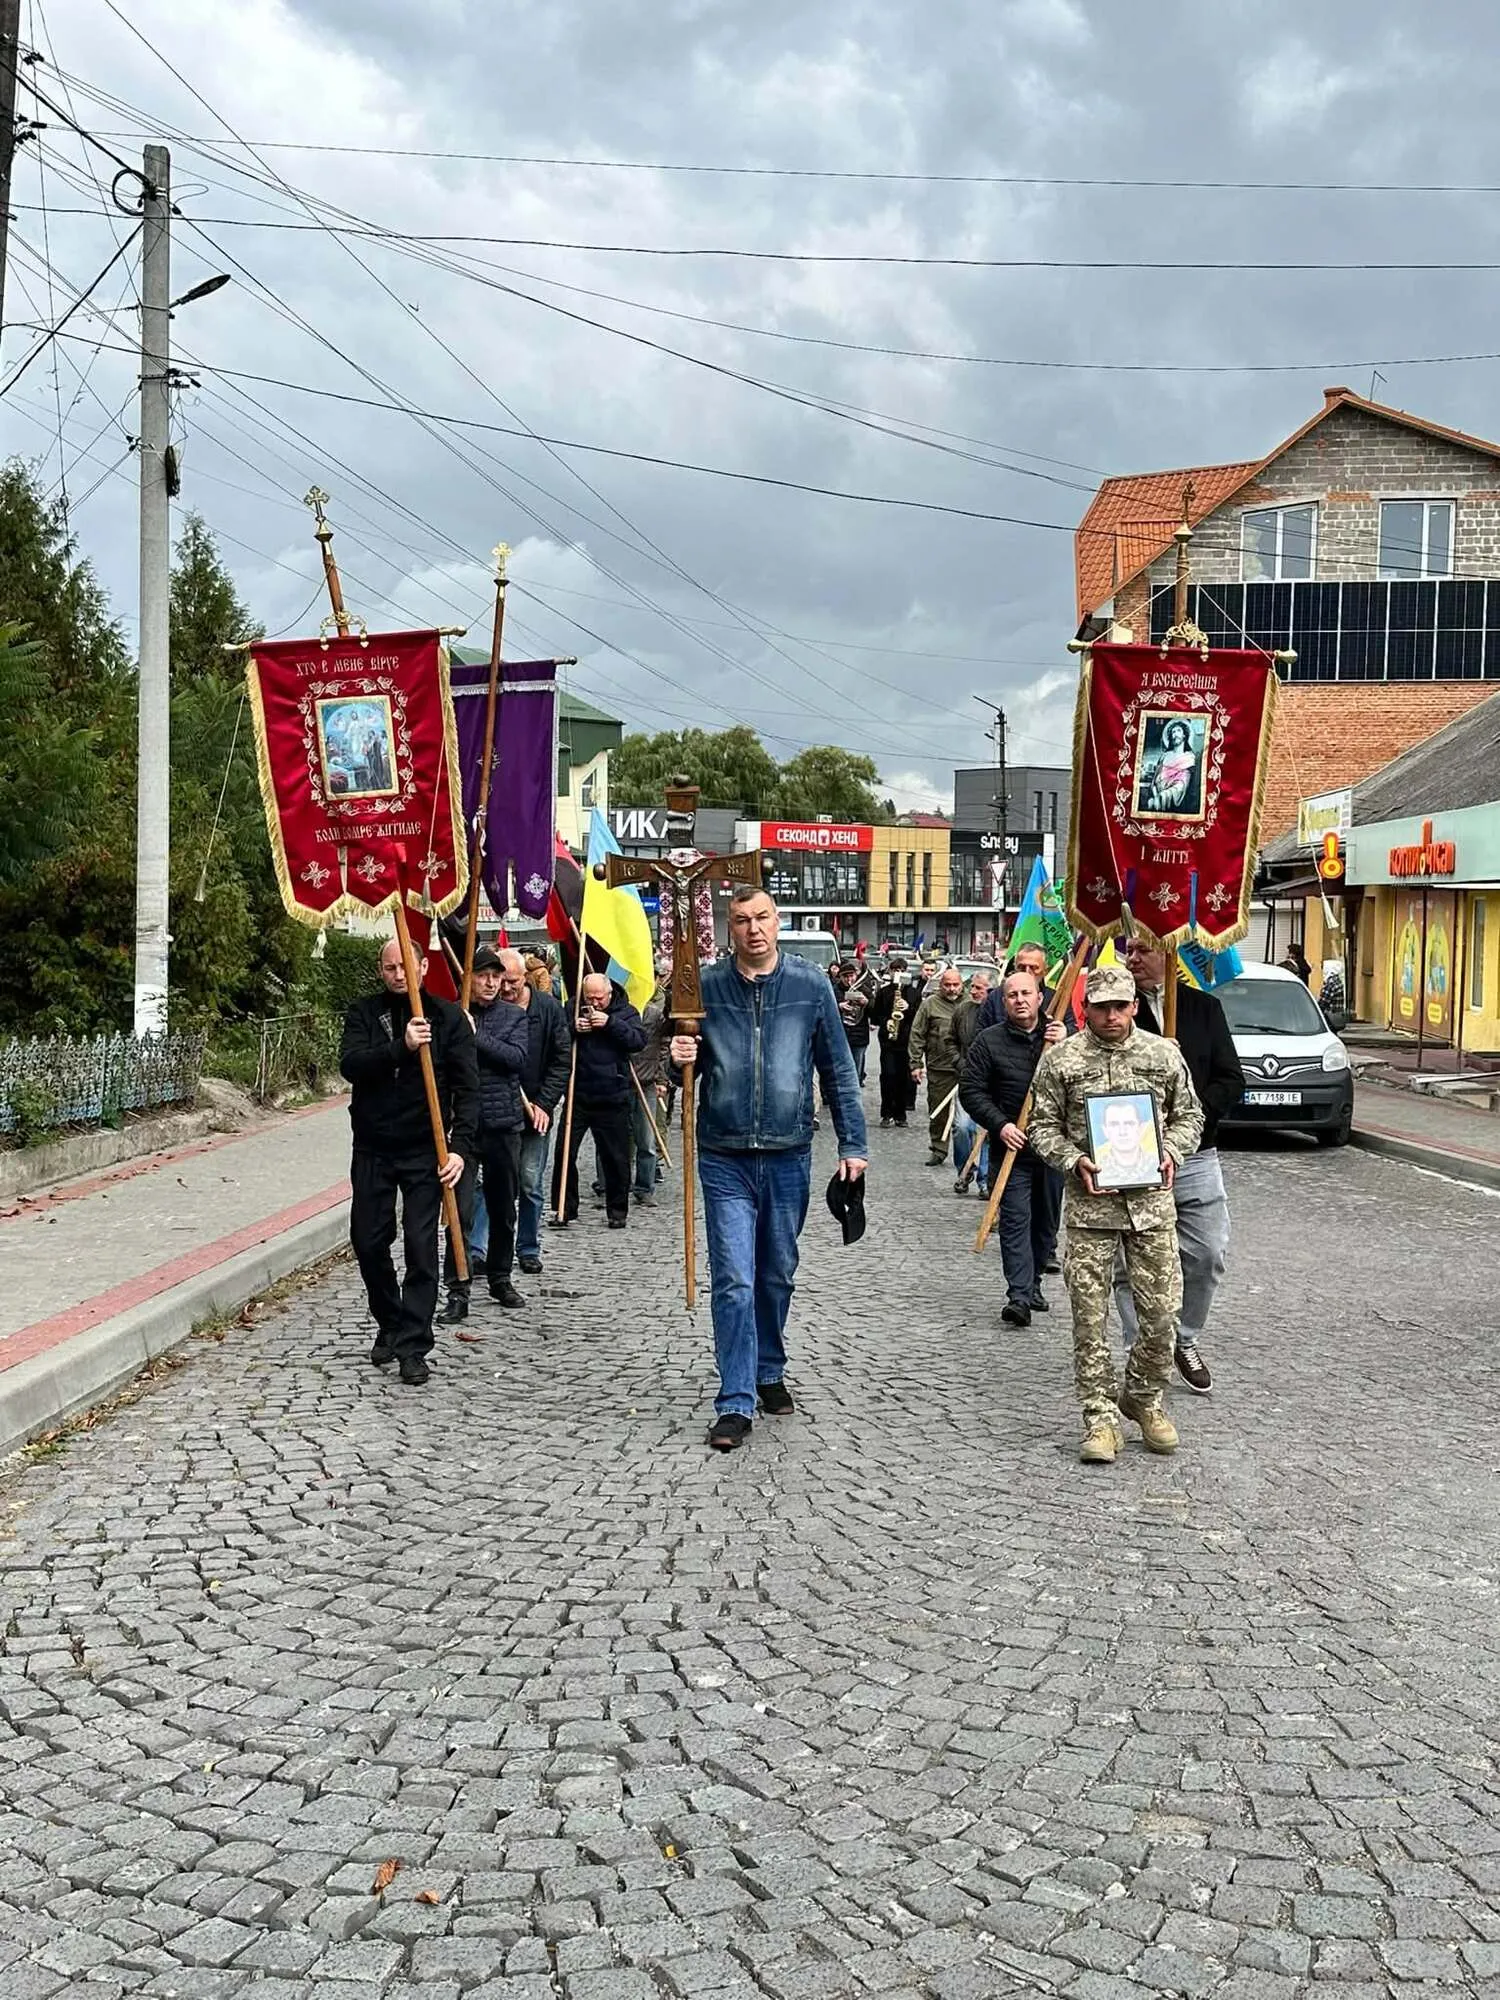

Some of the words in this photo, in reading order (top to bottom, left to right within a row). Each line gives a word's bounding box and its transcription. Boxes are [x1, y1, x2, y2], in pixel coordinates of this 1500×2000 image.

[296, 662, 316, 677] ХТО
[334, 657, 364, 673] МЕНЕ
[1141, 672, 1149, 686] Я
[609, 810, 669, 838] ИК
[777, 828, 817, 845] СЕКОНД
[832, 831, 859, 847] ХЕНД
[1250, 1093, 1262, 1101] AT
